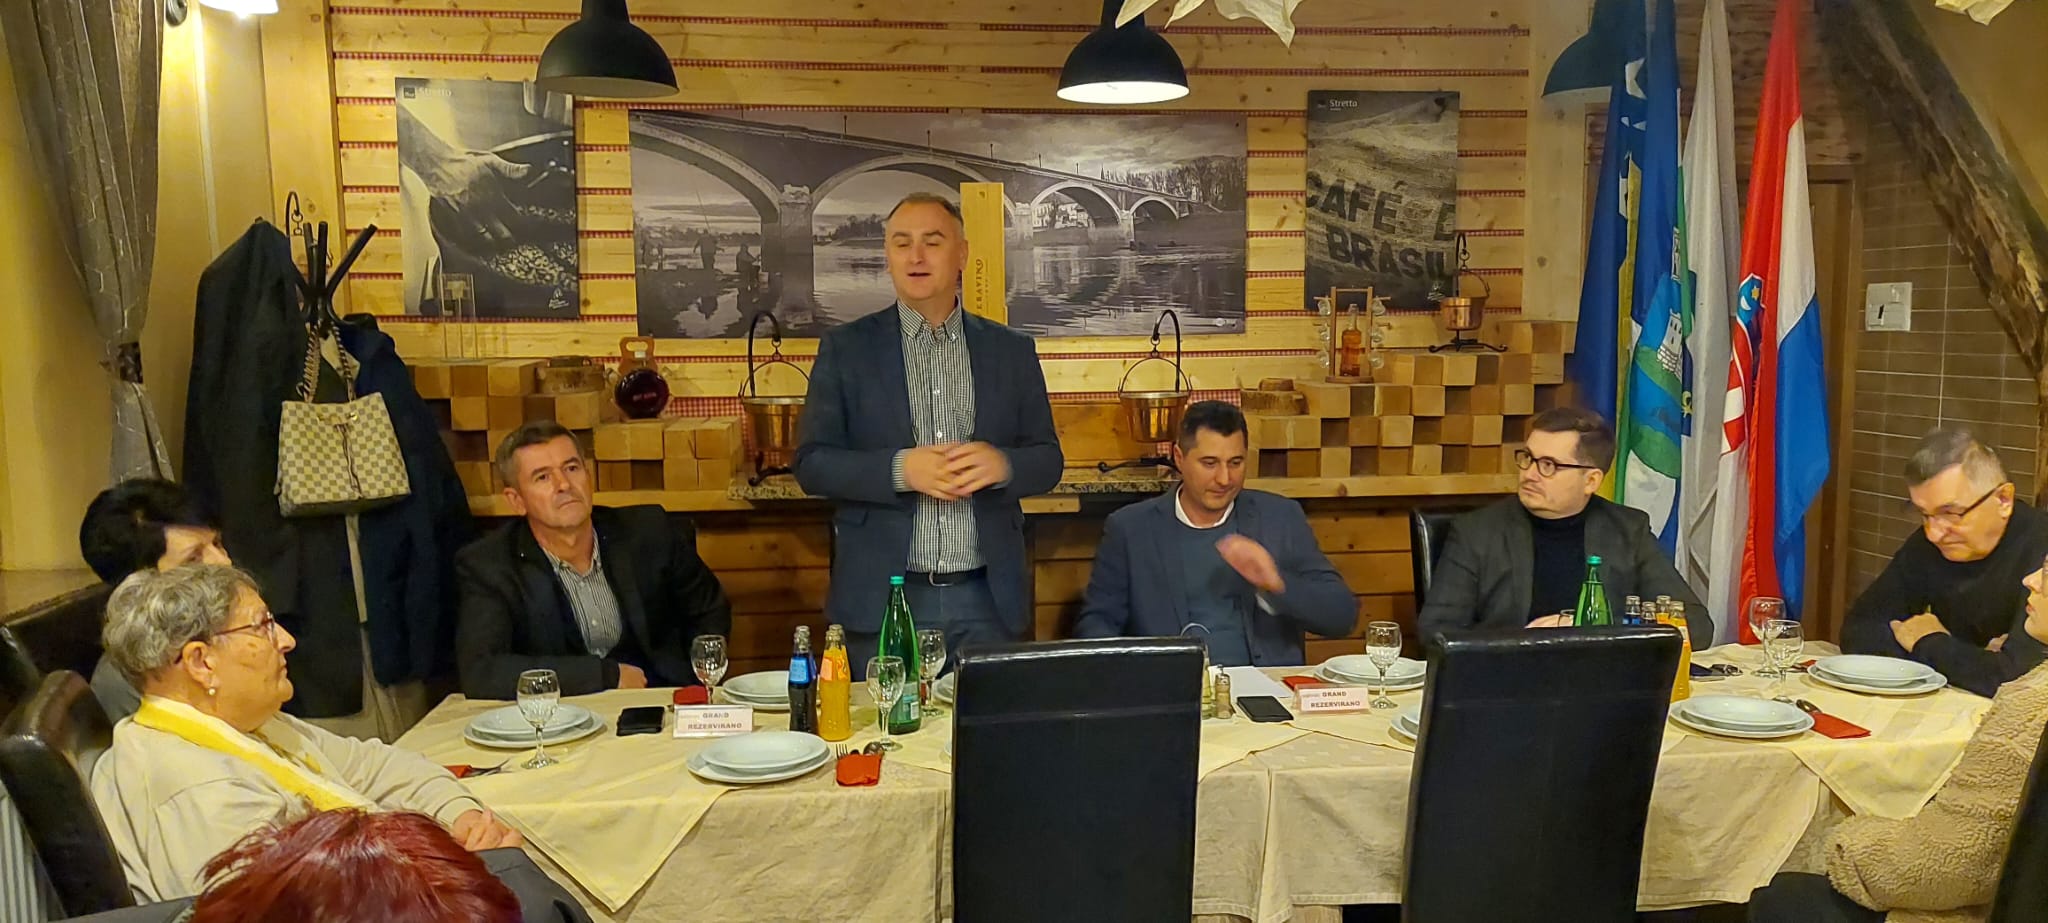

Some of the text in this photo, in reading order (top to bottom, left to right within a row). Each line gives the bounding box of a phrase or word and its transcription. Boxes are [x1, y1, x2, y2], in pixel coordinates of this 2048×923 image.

[1329, 98, 1358, 108] Stretto
[1310, 700, 1361, 708] REZERVIRANO
[687, 722, 742, 730] REZERVIRANO
